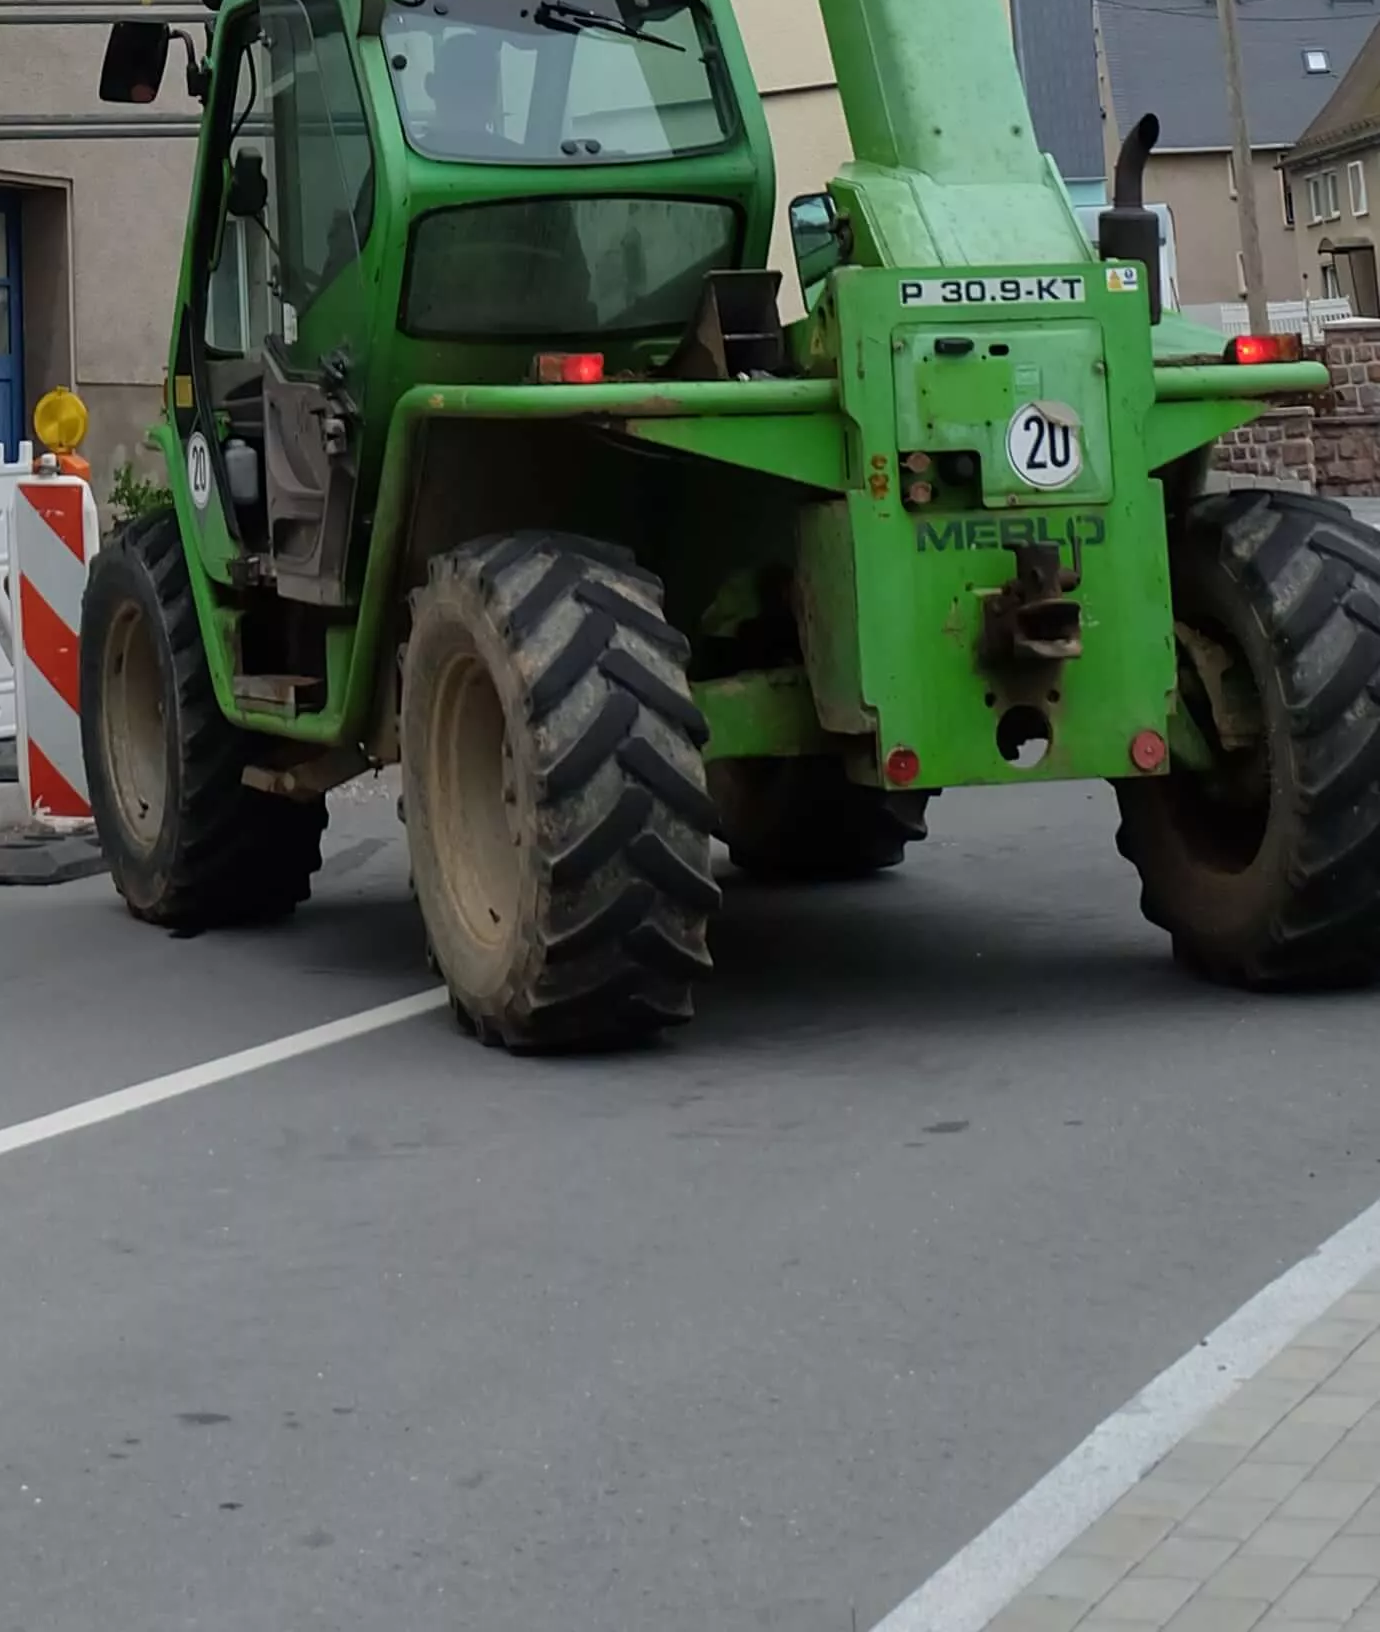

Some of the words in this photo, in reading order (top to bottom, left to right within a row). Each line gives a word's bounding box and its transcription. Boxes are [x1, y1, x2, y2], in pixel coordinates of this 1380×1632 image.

[901, 282, 923, 304] P
[941, 278, 1082, 304] 30.9-KT
[191, 445, 206, 492] 20
[916, 514, 1106, 553] MERLO
